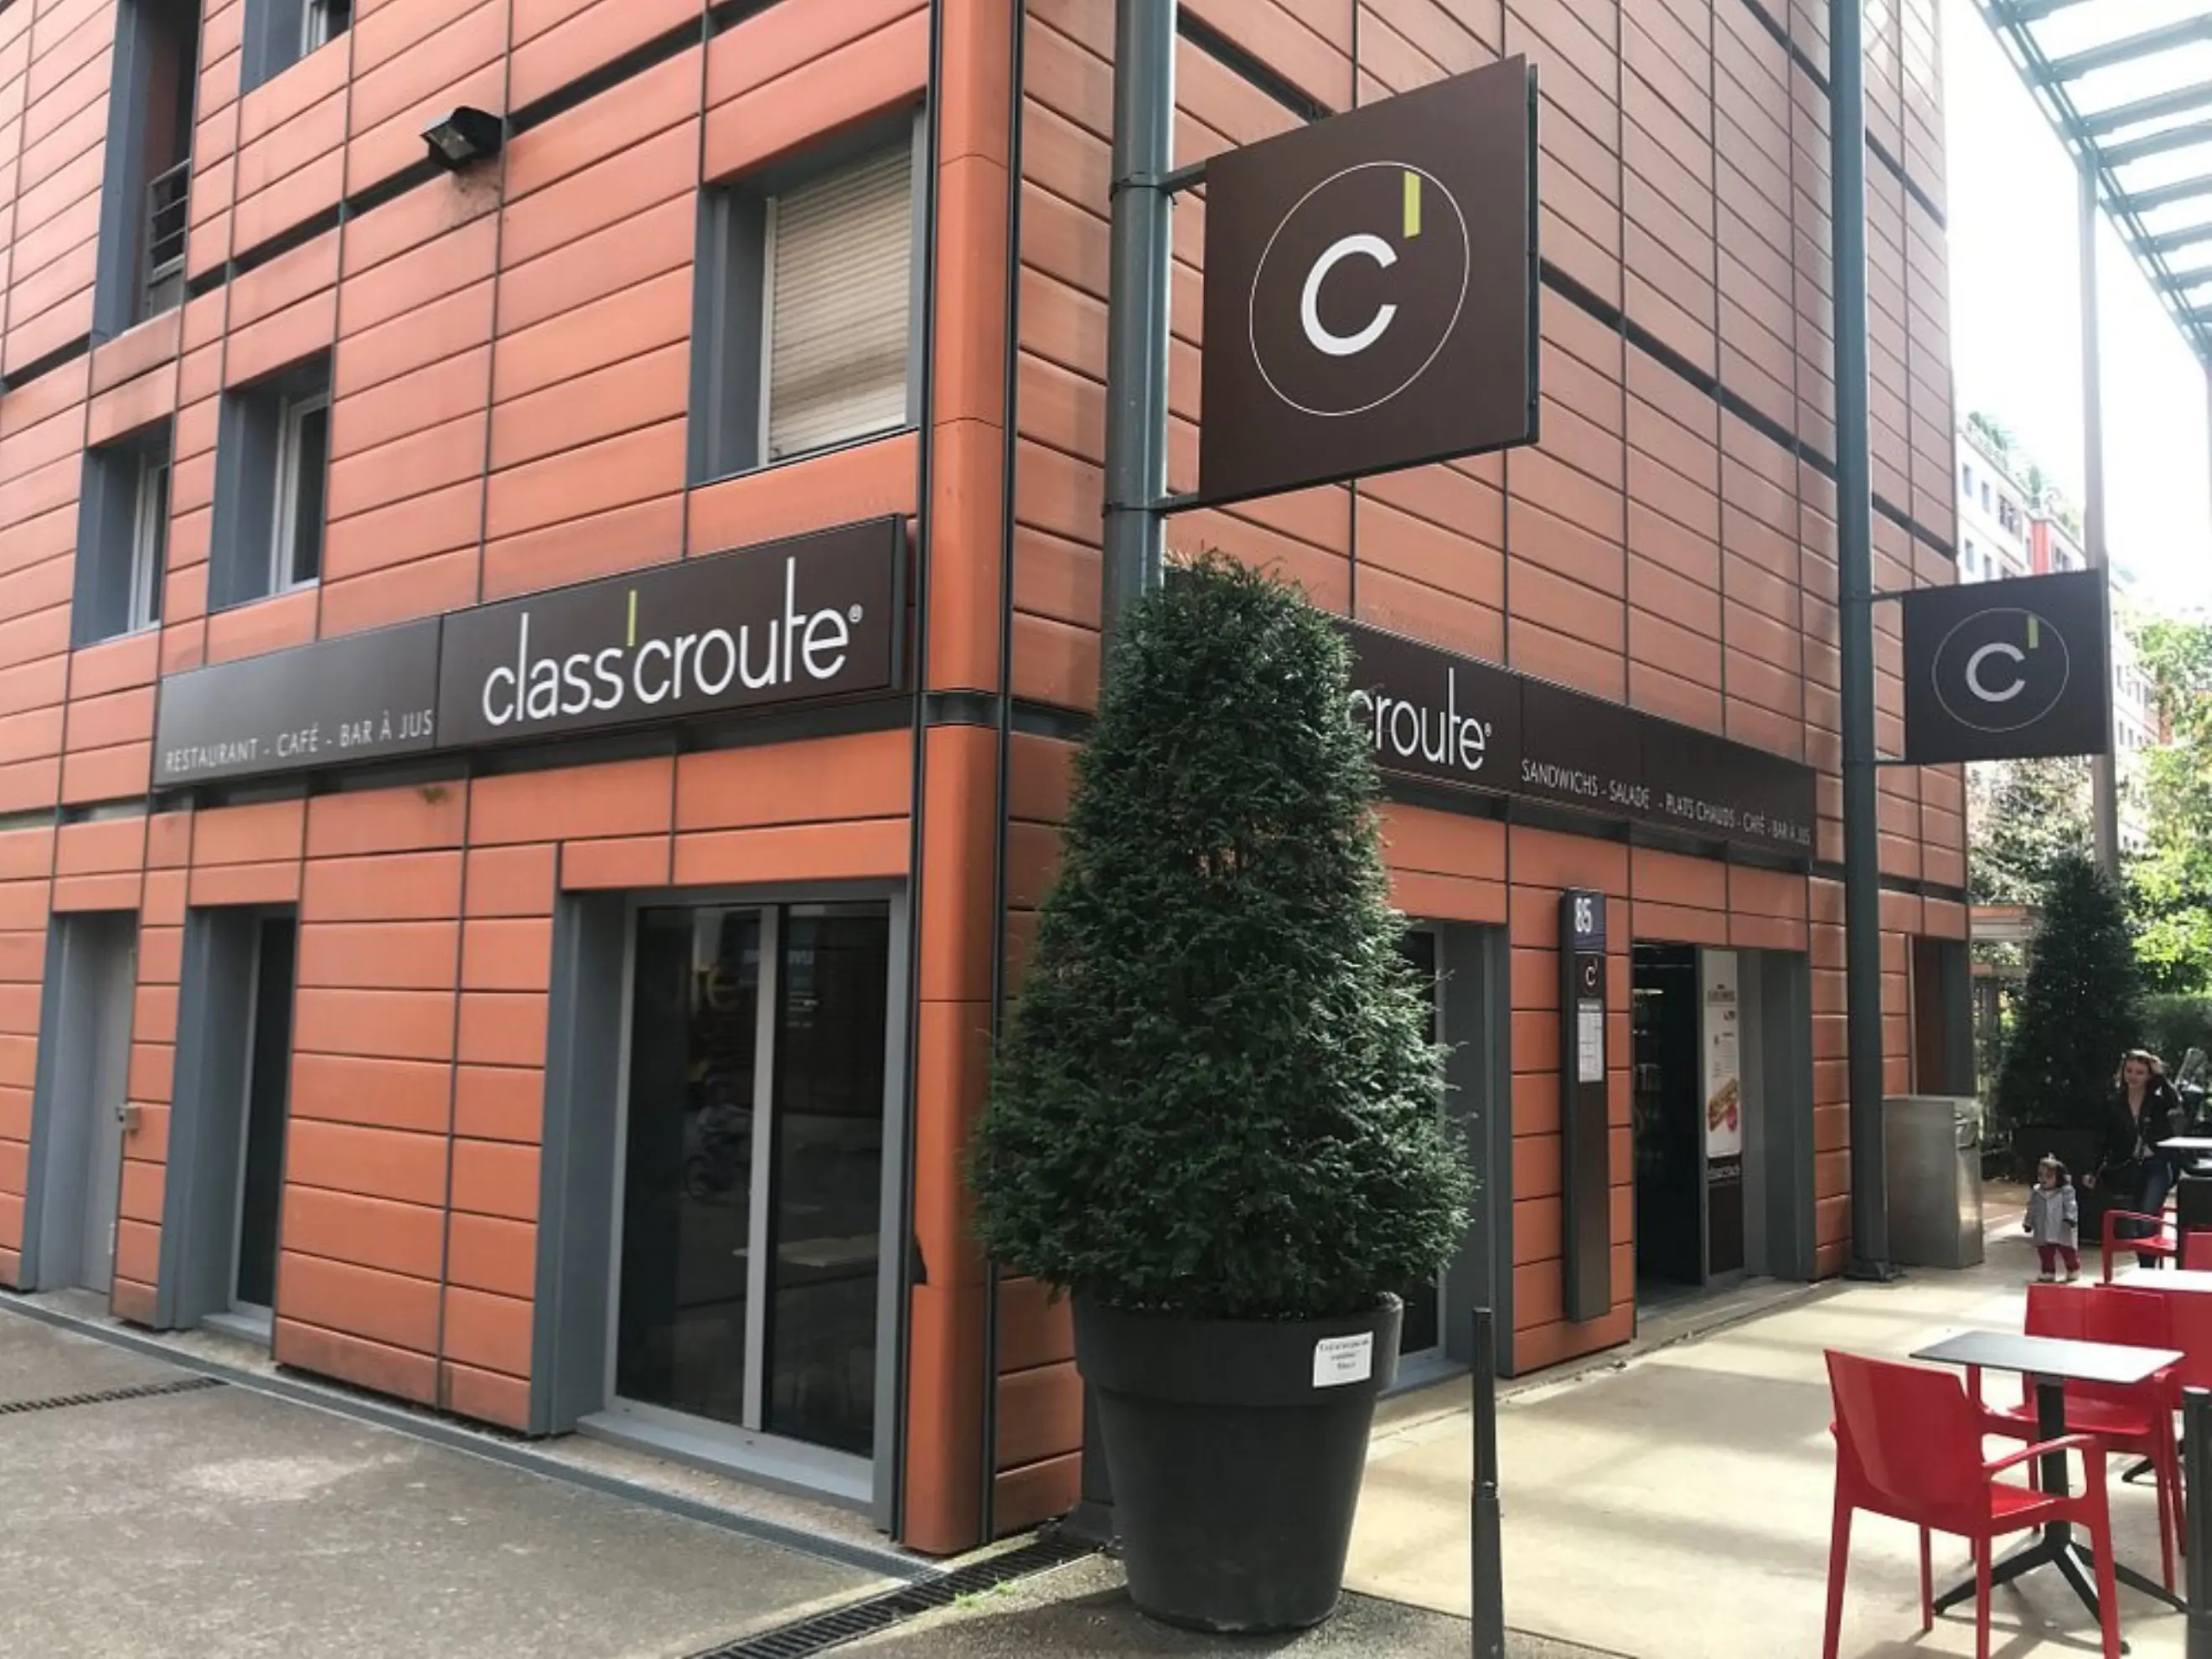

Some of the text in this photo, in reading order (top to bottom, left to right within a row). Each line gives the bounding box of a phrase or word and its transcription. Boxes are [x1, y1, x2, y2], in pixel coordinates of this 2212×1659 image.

[166, 738, 258, 772] RESTAURANT
[276, 722, 318, 757] CAFÉ
[339, 721, 372, 747] BAR
[399, 709, 432, 739] JUS
[1522, 757, 1598, 797] SANDWICHS
[1609, 779, 1650, 810] SALADE
